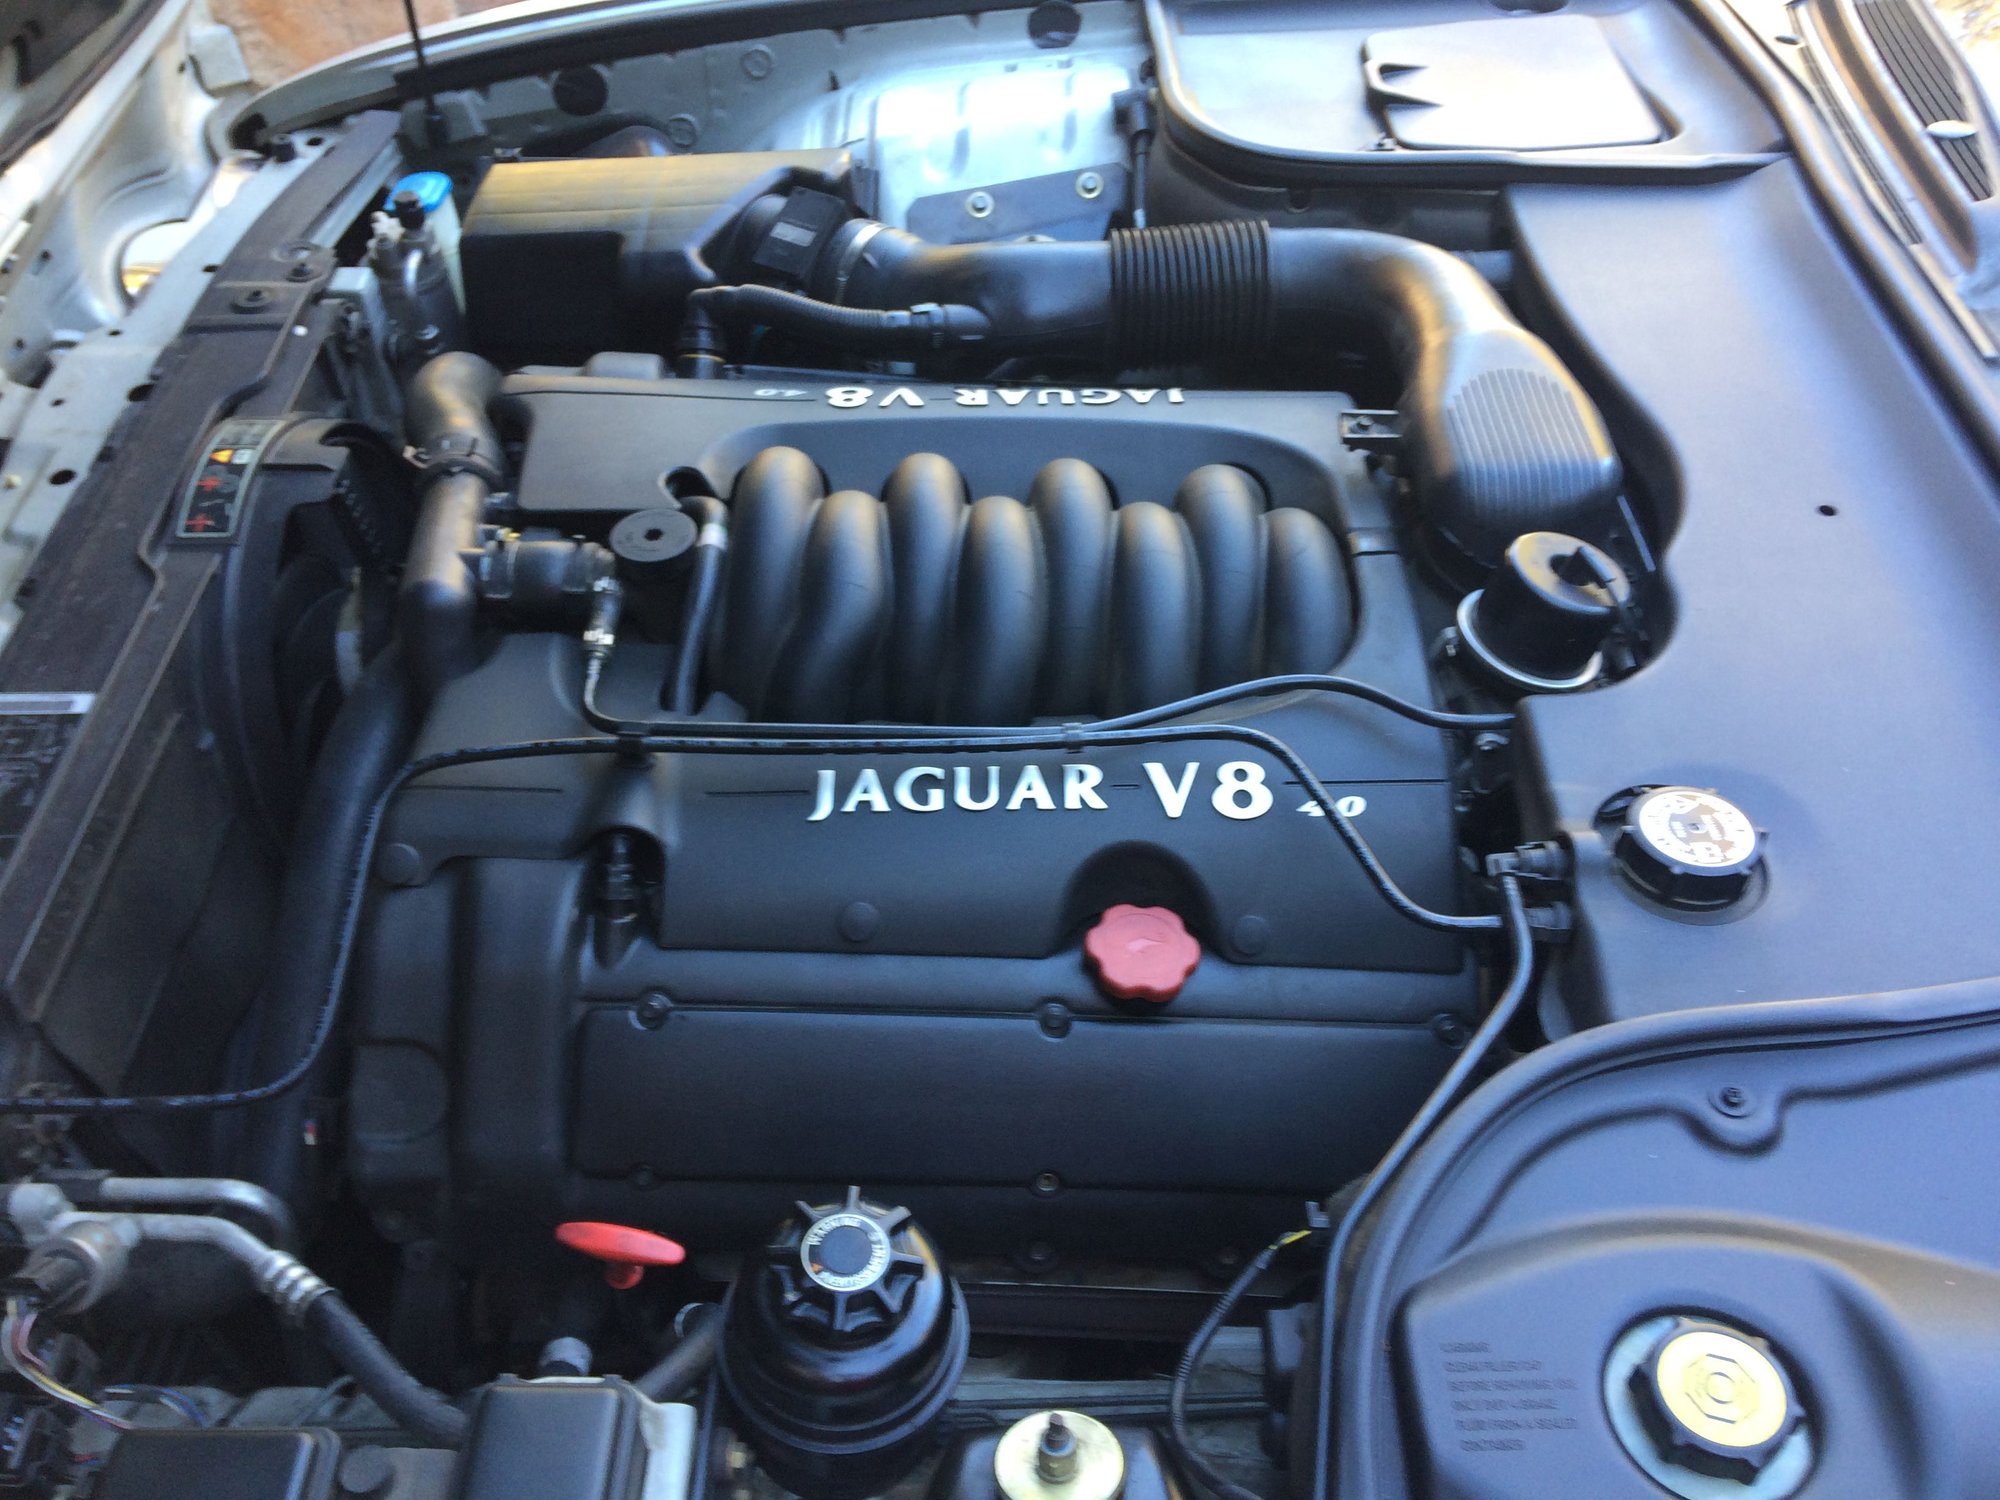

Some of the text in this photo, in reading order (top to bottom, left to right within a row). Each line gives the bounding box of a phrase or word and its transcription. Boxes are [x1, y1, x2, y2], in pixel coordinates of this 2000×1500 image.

[825, 386, 926, 408] V8
[953, 388, 1185, 406] JAGUAR
[806, 764, 1109, 821] JAGUAR
[1142, 761, 1274, 819] V8
